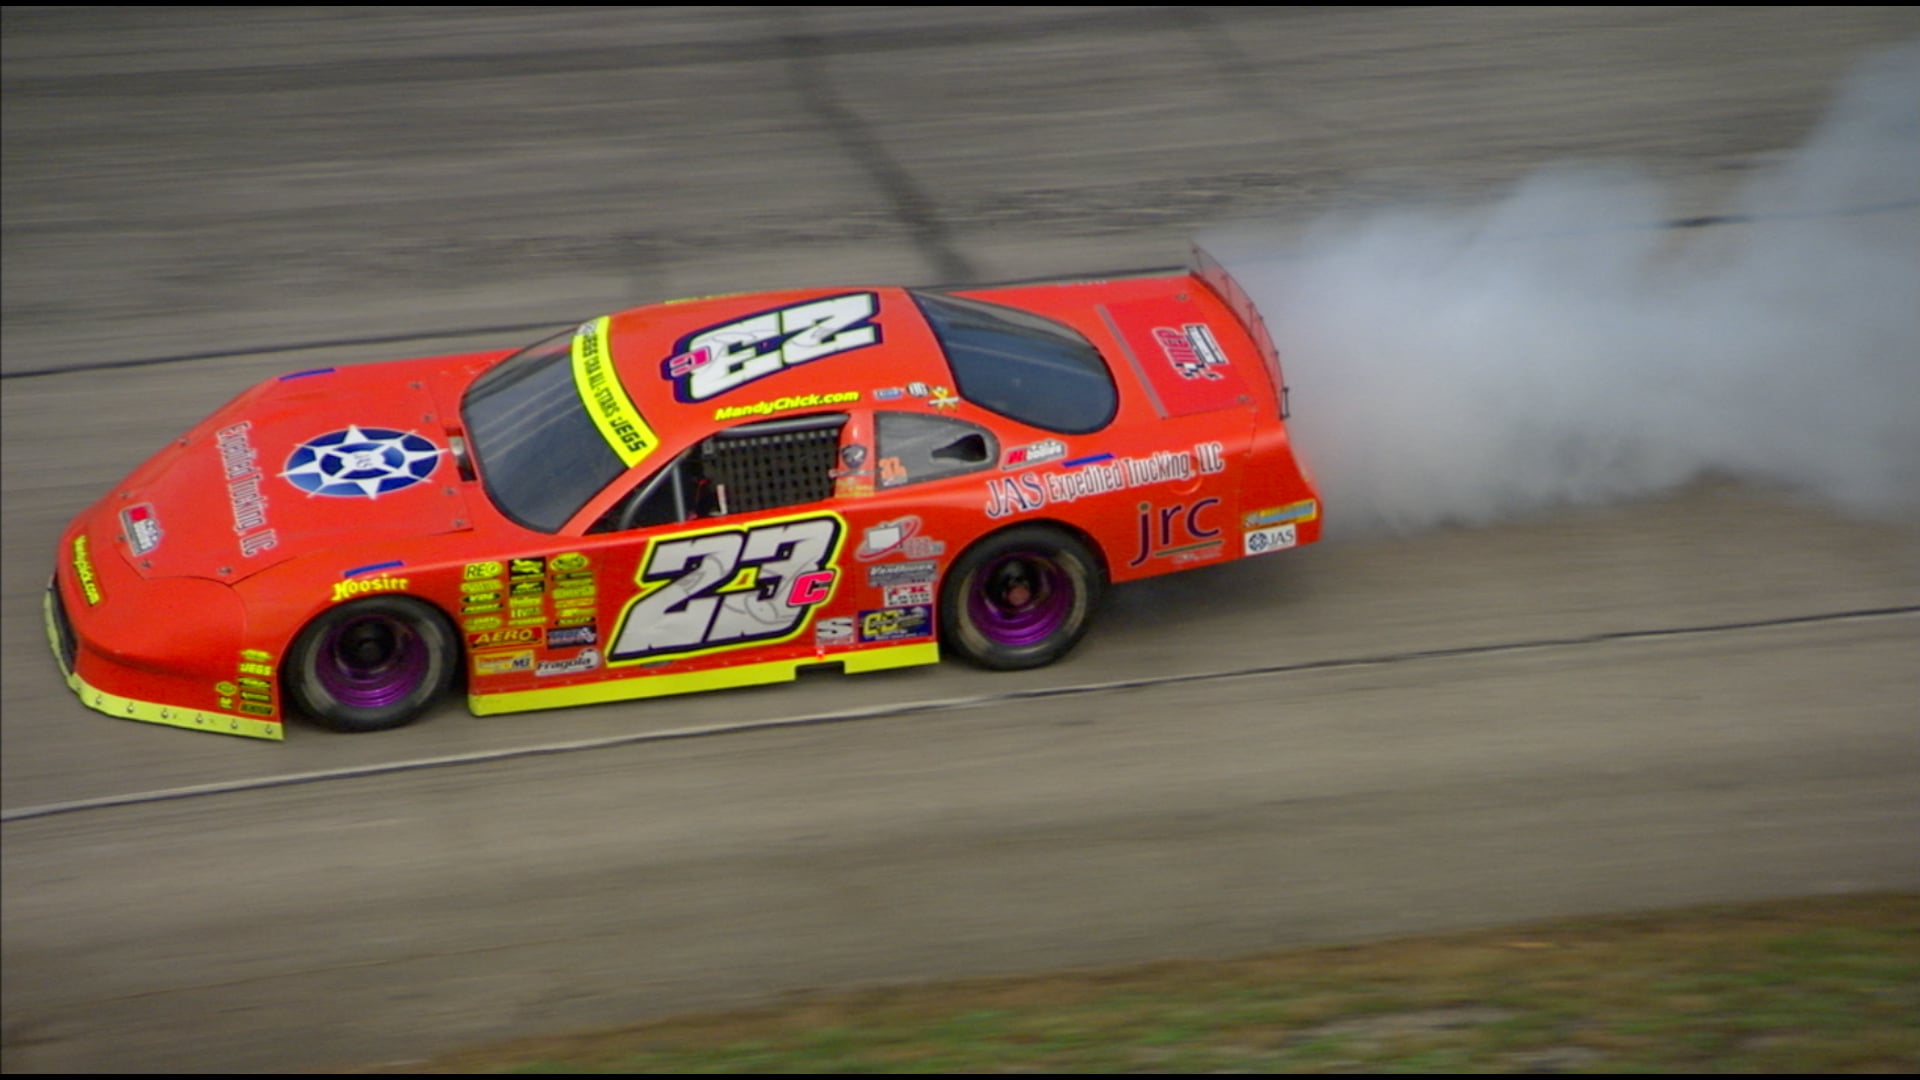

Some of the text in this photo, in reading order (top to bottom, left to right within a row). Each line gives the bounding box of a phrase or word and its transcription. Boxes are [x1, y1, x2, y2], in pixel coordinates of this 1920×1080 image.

[687, 292, 878, 400] 23
[714, 391, 860, 421] MandyChick.com
[217, 421, 261, 480] Expedited
[241, 529, 277, 557] LLC
[986, 473, 1044, 517] JAS
[1046, 462, 1123, 501] Expedited
[1195, 442, 1224, 474] LLC
[1130, 498, 1220, 567] jrc
[1269, 528, 1294, 547] JAS
[331, 573, 408, 602] Hoosier
[608, 514, 837, 660] 23 C
[475, 630, 533, 645] AERO
[537, 657, 592, 672] Fragola
